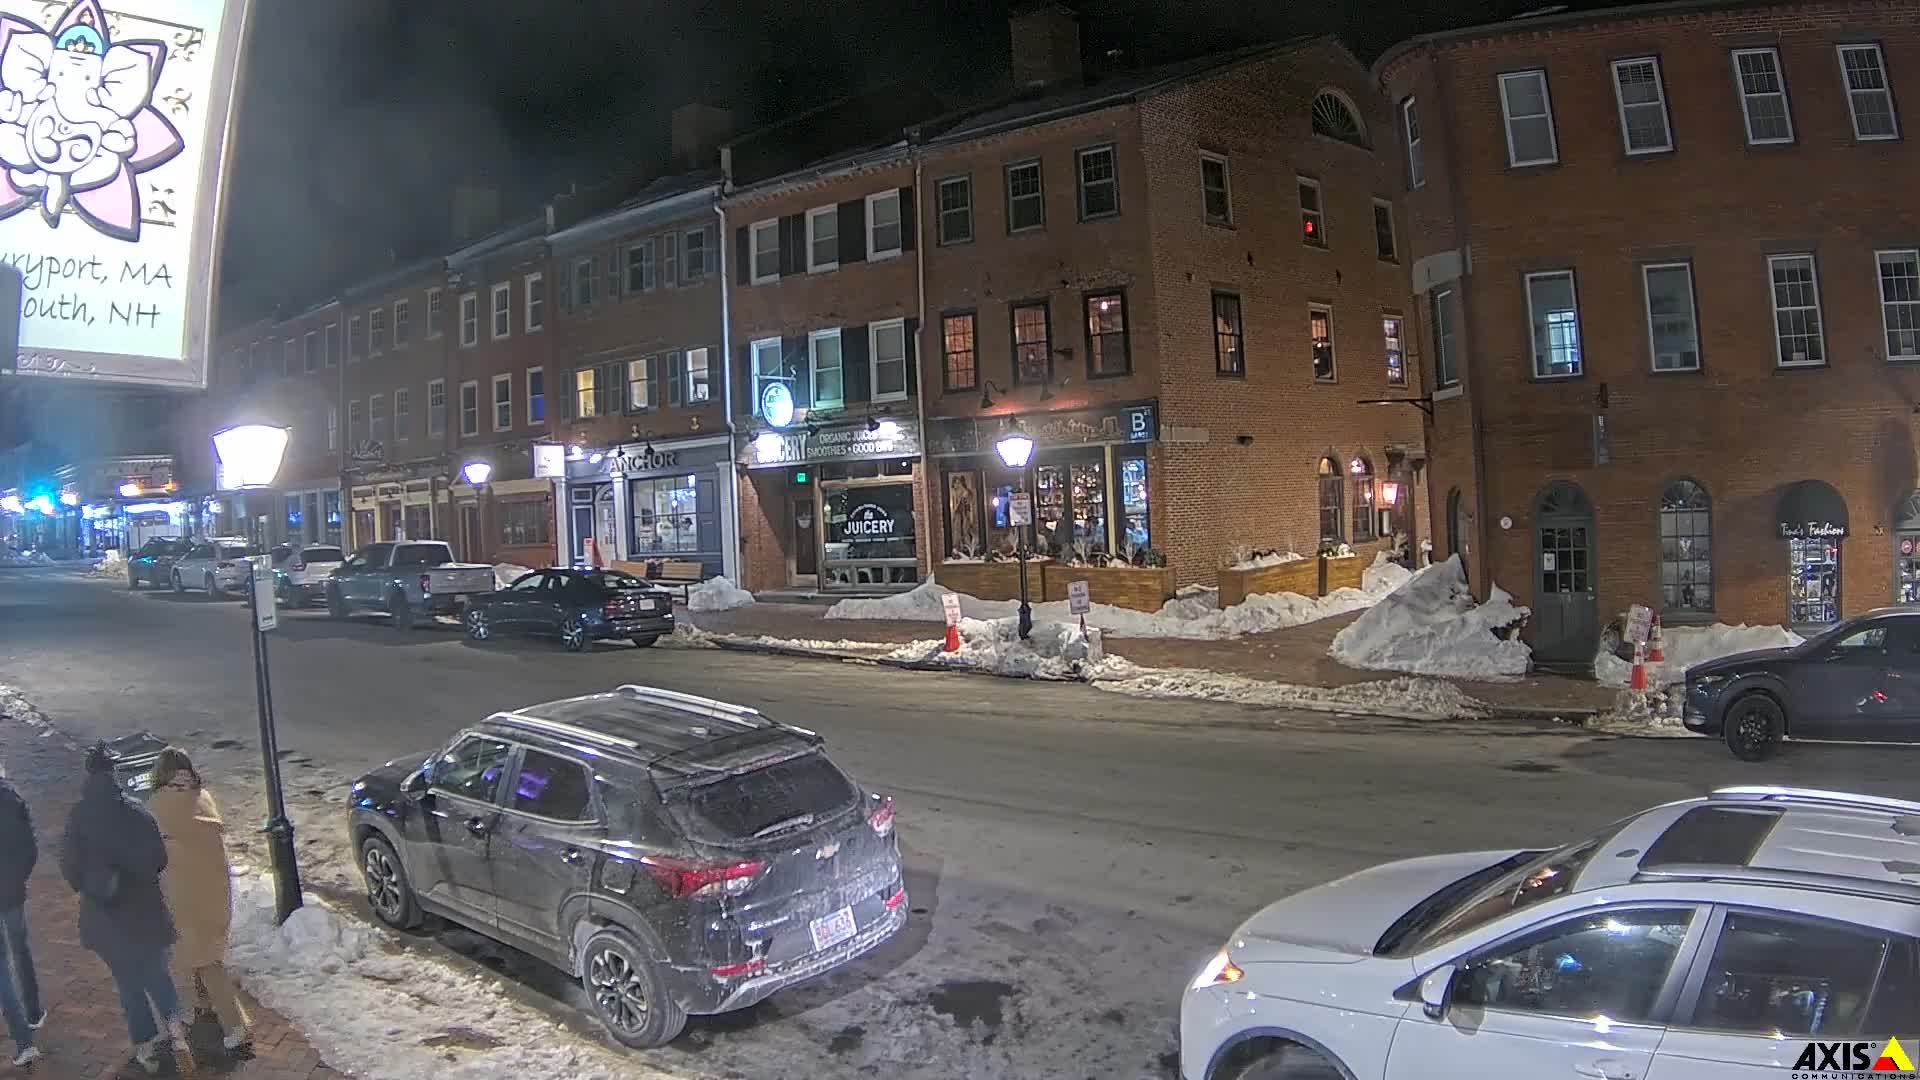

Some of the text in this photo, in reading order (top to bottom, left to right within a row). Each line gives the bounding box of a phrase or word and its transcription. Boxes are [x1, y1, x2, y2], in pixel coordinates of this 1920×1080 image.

[120, 260, 172, 288] MA
[109, 301, 160, 328] NH
[819, 432, 851, 444] ORGANIC
[806, 445, 847, 457] SMOOTHIES
[852, 442, 874, 453] GOOD
[609, 452, 679, 472] ANCHOR
[844, 519, 894, 534] JUICERY
